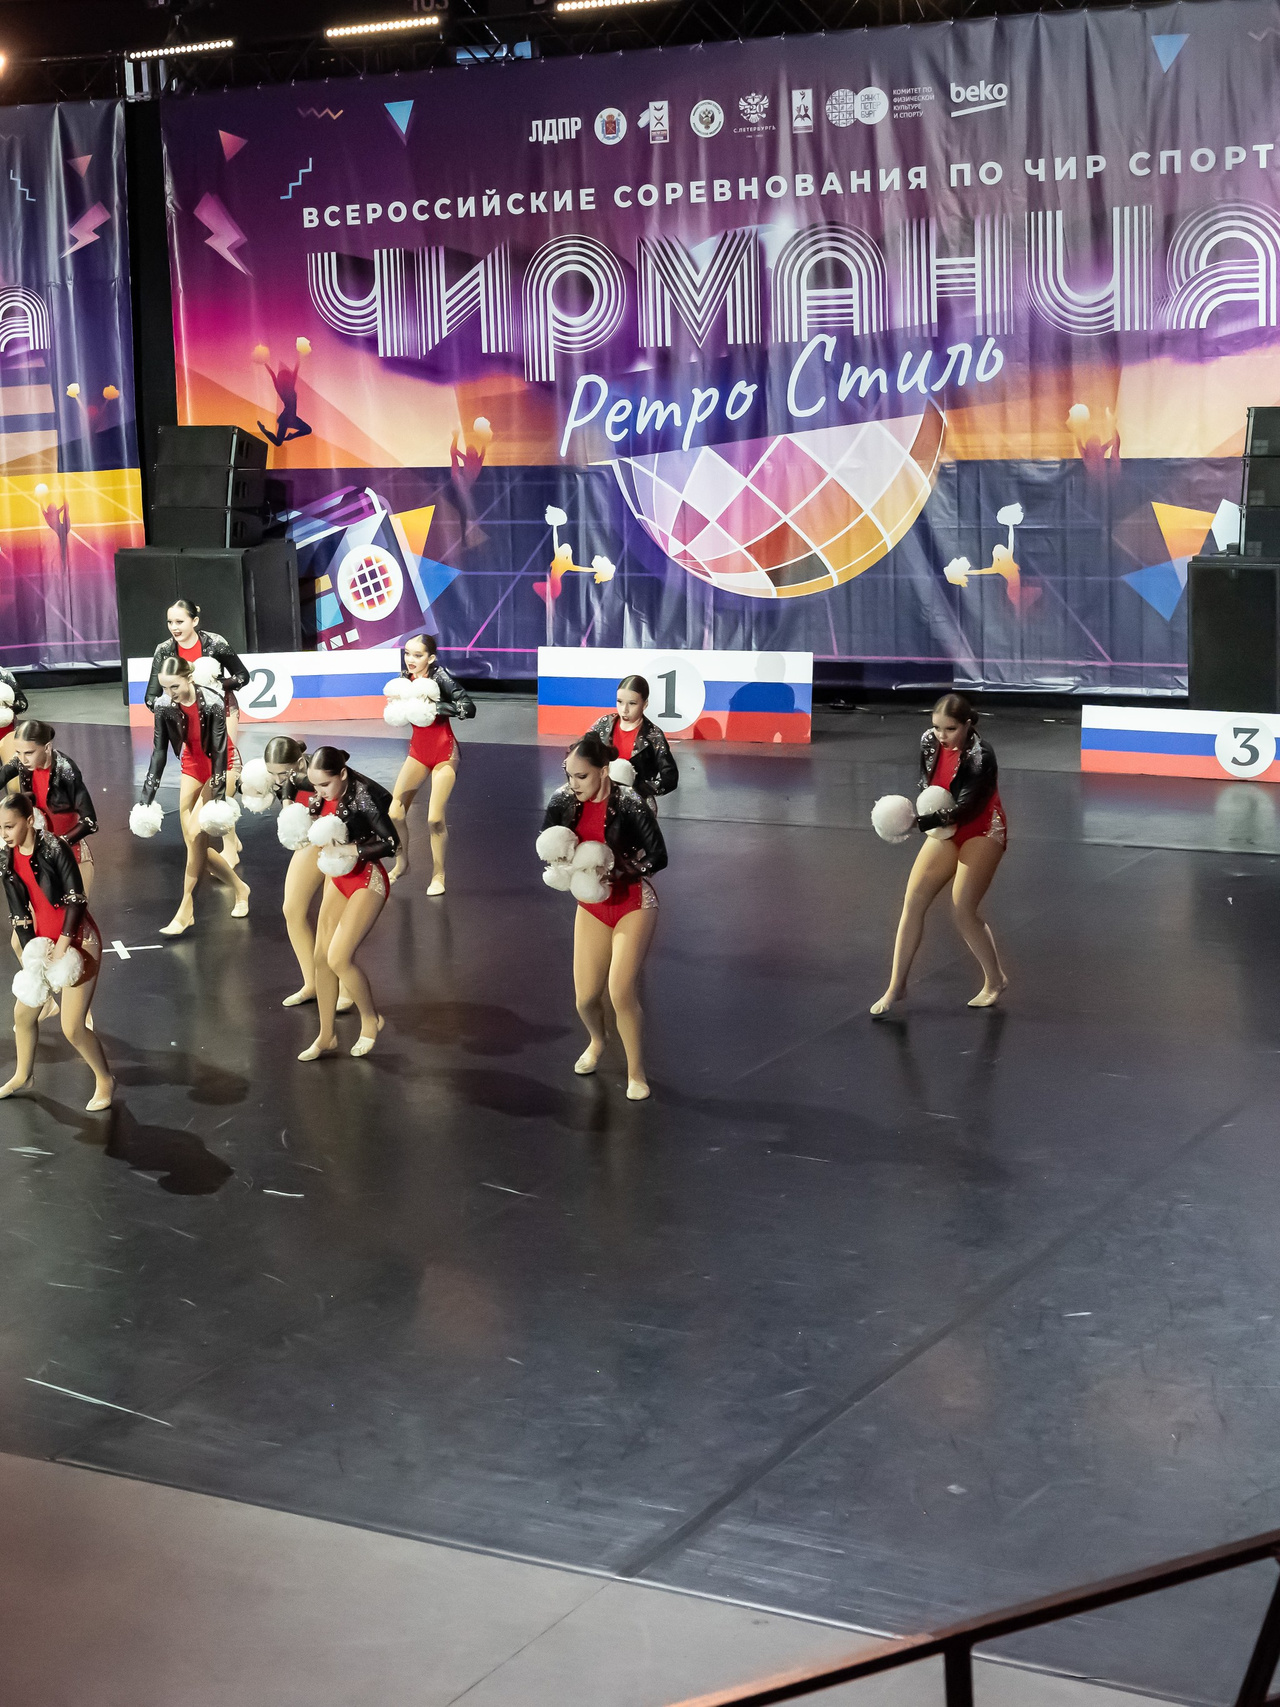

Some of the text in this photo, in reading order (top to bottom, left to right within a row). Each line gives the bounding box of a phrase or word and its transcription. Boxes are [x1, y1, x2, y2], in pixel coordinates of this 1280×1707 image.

[892, 94, 935, 103] ФИЗИЧЕСКОЙ
[893, 103, 922, 111] КУЛЬТУРЕ
[950, 80, 1008, 104] beko
[528, 117, 582, 144] ЛДПР
[302, 144, 1274, 229] ВСЕРОССИЙСКИЕ СОРЕВНОВАНИЯ ПО ЧИР СПОРТ
[559, 334, 1005, 457] Ретро Стиль
[249, 668, 277, 708] 2
[657, 670, 682, 718] 1
[1231, 727, 1260, 767] 3
